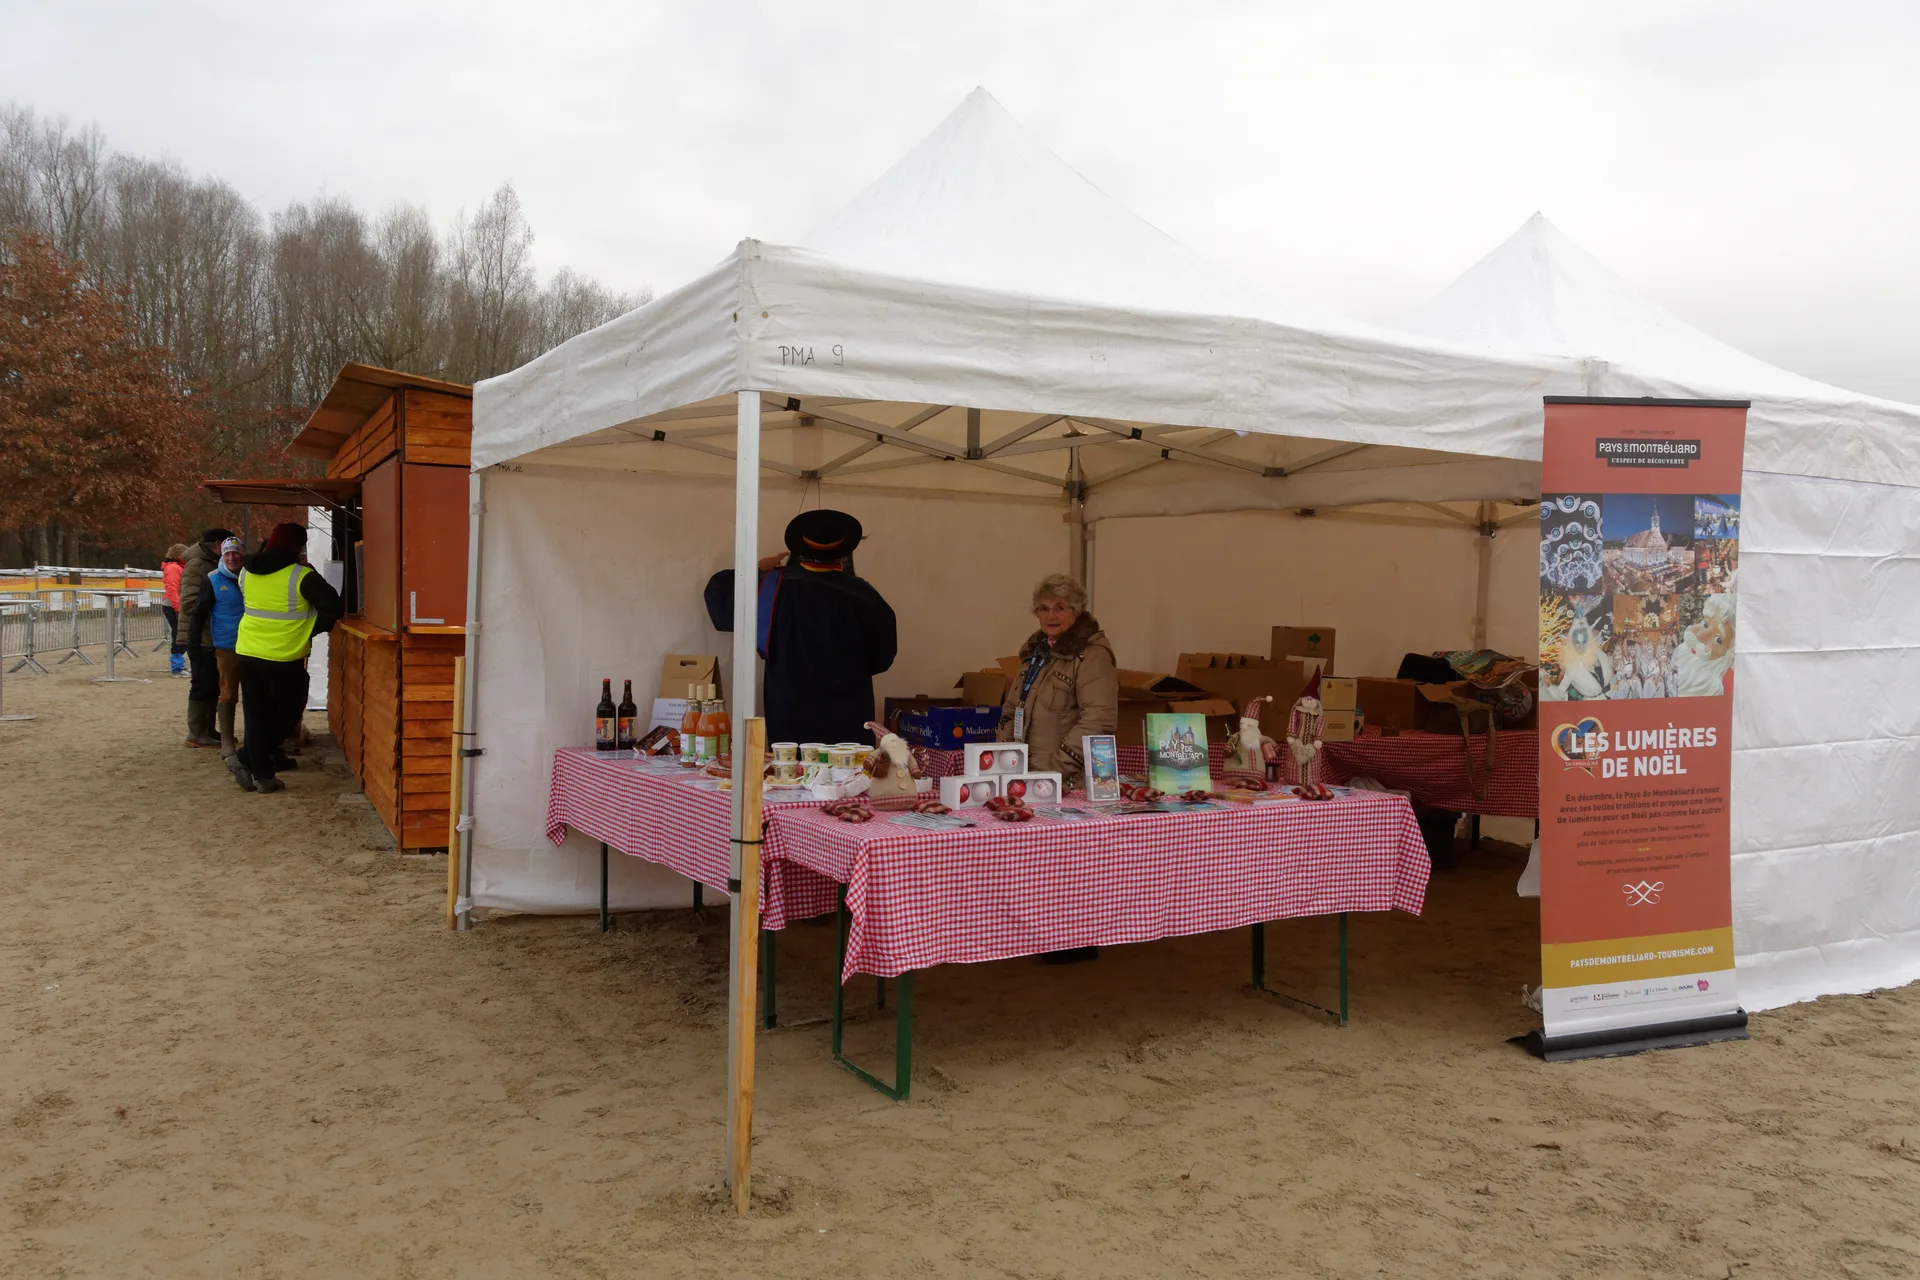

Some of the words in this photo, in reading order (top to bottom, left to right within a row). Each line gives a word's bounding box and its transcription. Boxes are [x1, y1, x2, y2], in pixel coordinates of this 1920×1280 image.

[778, 345, 815, 366] PMA
[832, 344, 843, 366] 9
[1571, 732, 1609, 753] LES
[1615, 722, 1717, 751] LUMIÈRES
[1602, 757, 1628, 778] DE
[1634, 750, 1687, 776] NOËL
[1616, 801, 1650, 810] traditions
[1624, 791, 1641, 800] Pays
[1643, 790, 1651, 798] de
[1557, 816, 1568, 824] de
[1569, 813, 1601, 823] lumières
[1631, 810, 1647, 820] Noël
[1649, 811, 1661, 820] pas
[1570, 946, 1714, 968] PAYSDEMONTBELIARD-TOURISME.COM
